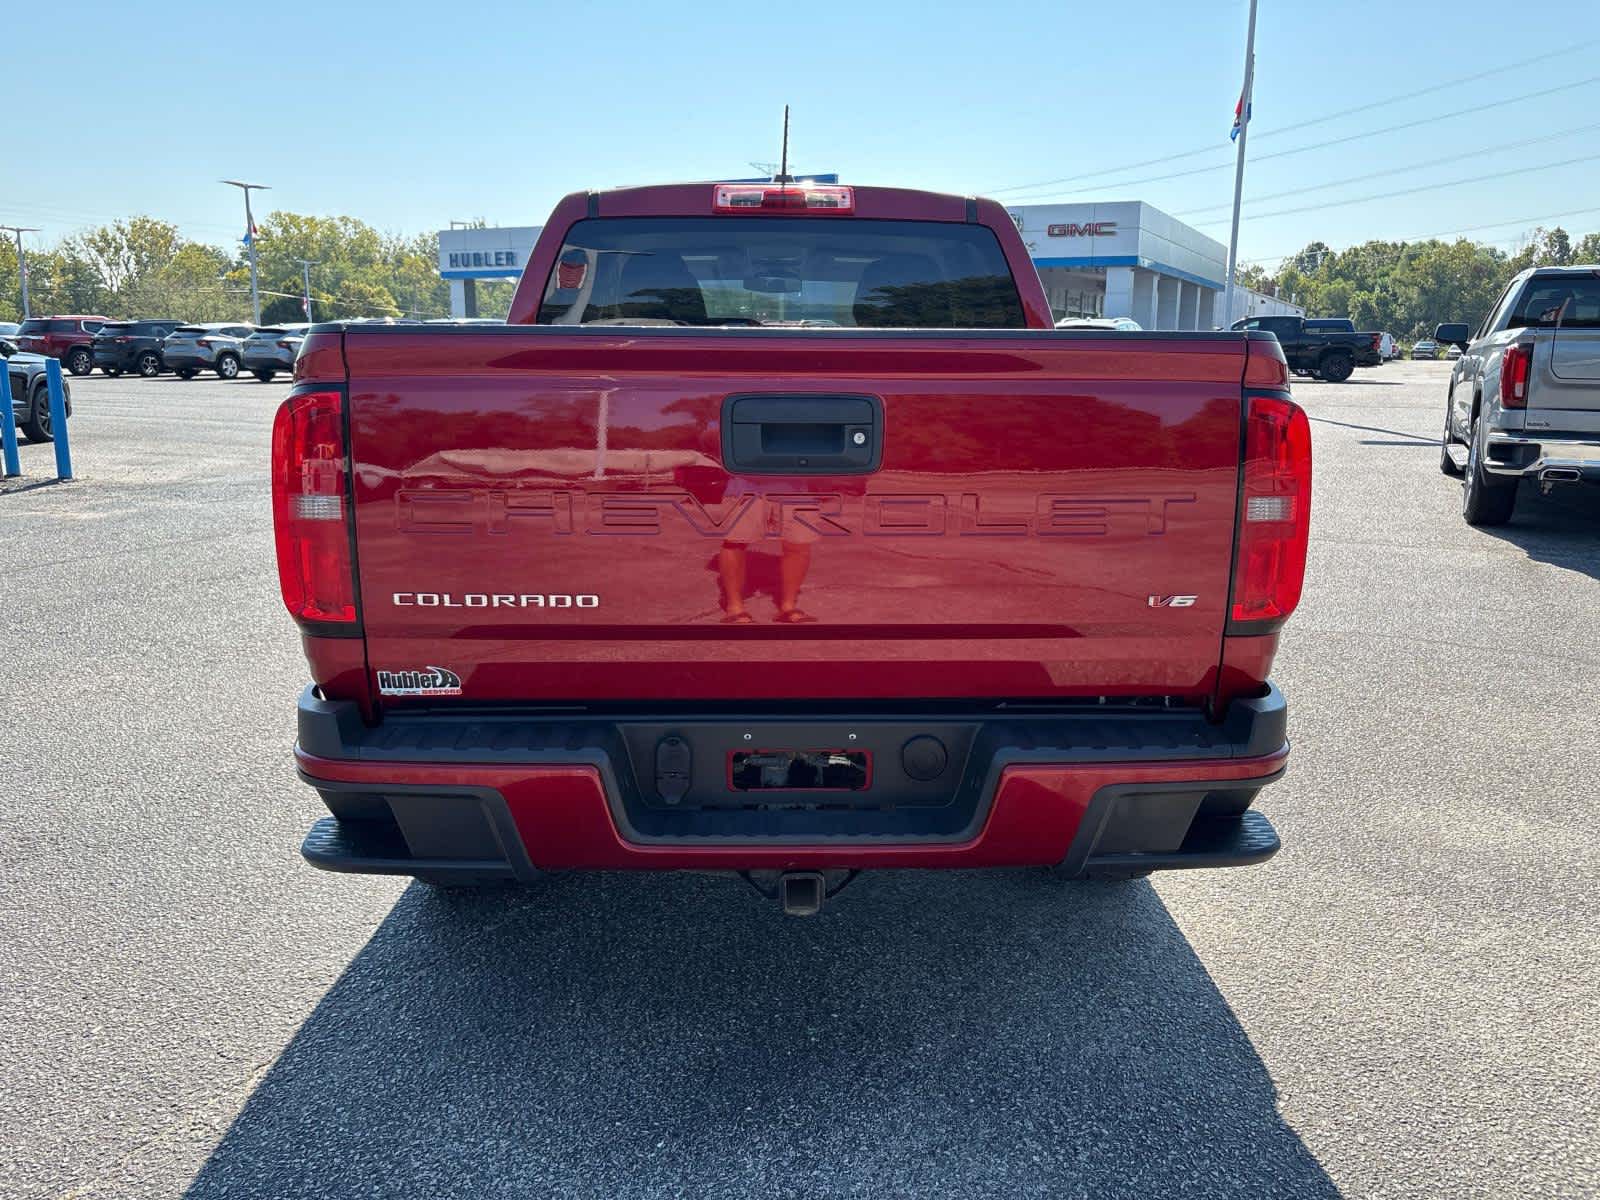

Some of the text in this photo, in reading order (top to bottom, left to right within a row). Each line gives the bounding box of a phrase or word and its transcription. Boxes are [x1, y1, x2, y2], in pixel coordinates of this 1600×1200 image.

[1047, 222, 1117, 237] GMC
[449, 251, 516, 268] HUBLER
[395, 489, 1196, 537] CHEVROLET
[393, 592, 600, 608] COLORADO
[1148, 594, 1198, 608] V6
[379, 671, 440, 689] Hubler
